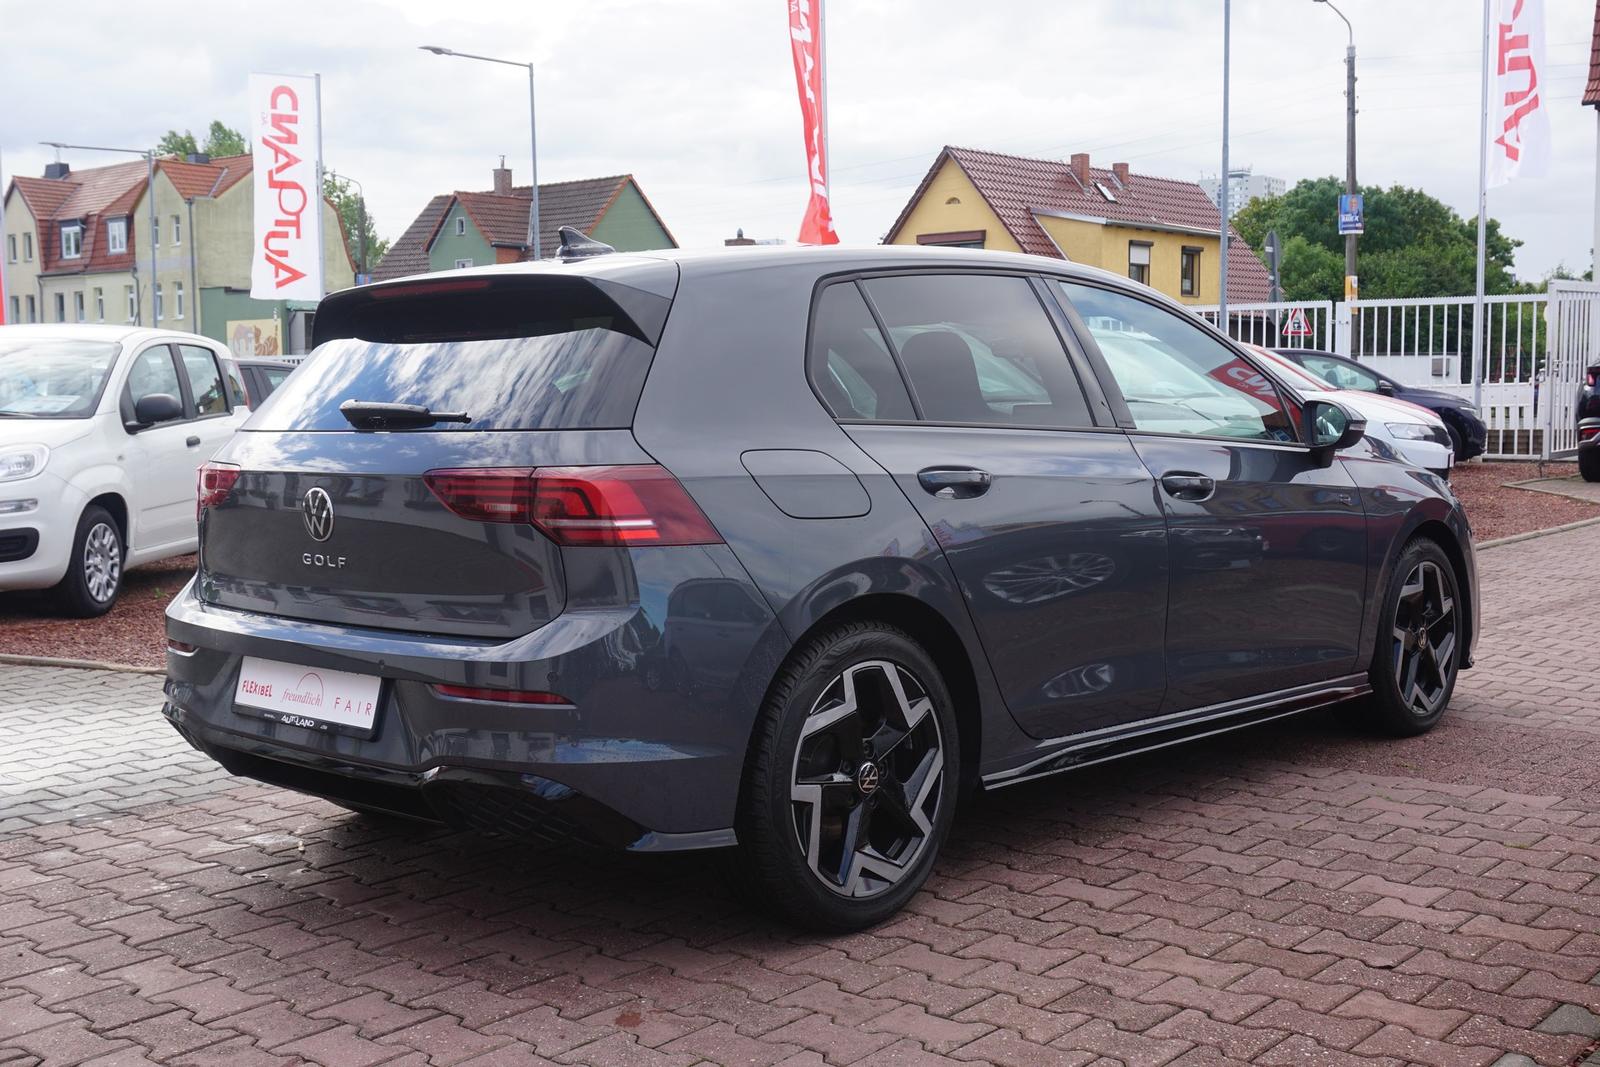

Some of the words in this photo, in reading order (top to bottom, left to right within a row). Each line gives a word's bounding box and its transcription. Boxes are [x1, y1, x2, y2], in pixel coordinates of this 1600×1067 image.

[1494, 0, 1540, 162] AUT
[302, 552, 347, 569] GOLF
[242, 679, 272, 698] FLEXIBEL
[281, 688, 323, 707] freundlich
[281, 714, 315, 728] AUTOLAND
